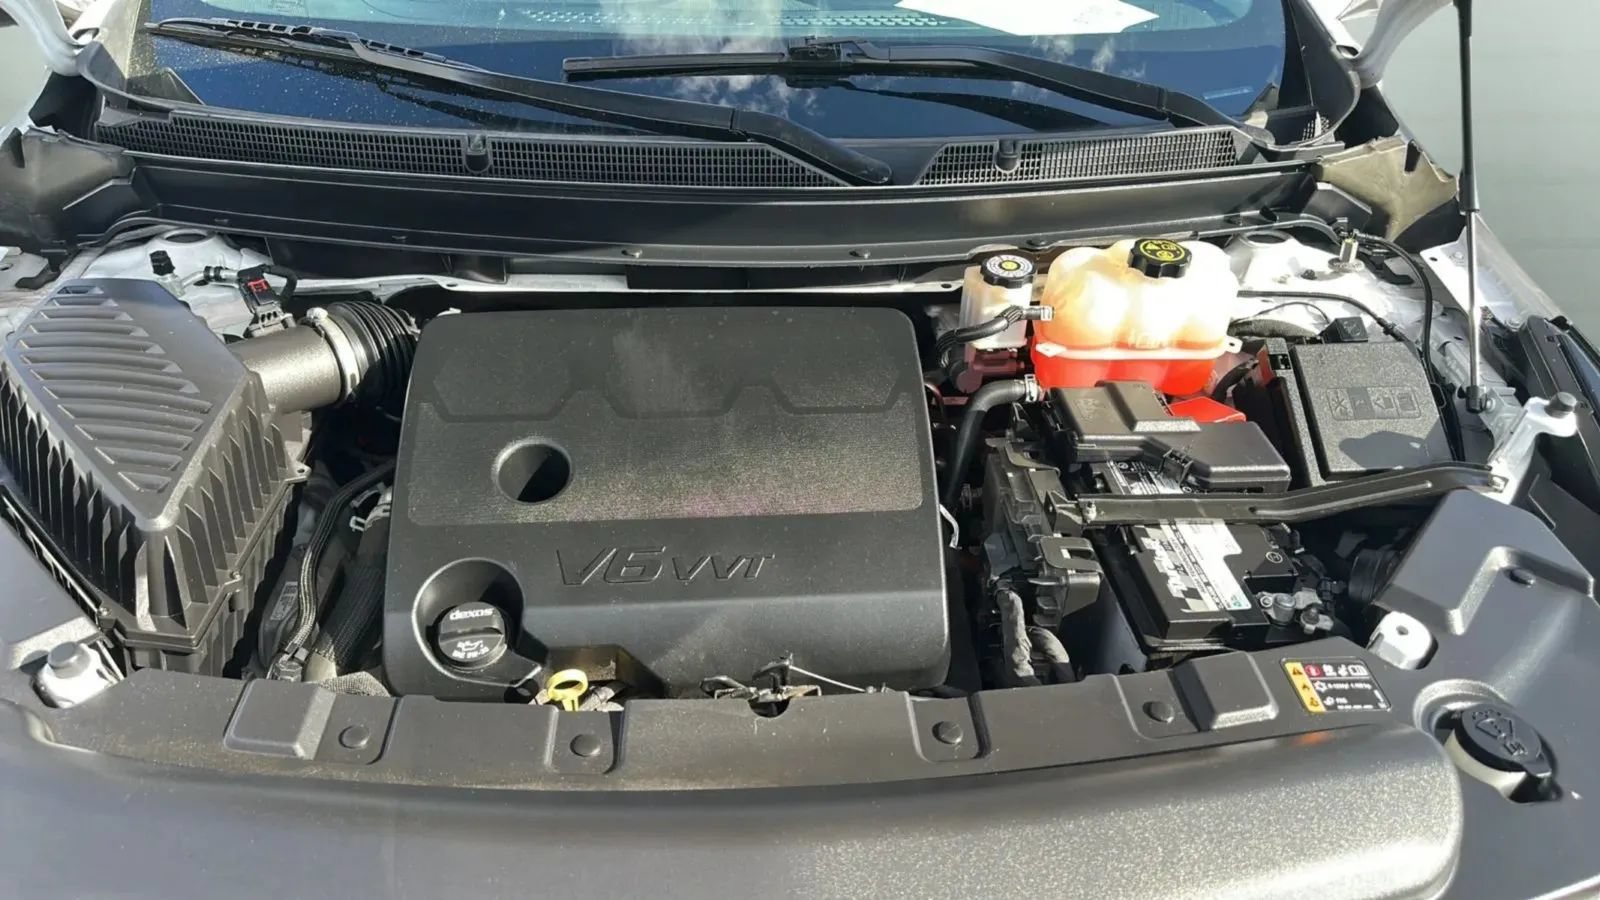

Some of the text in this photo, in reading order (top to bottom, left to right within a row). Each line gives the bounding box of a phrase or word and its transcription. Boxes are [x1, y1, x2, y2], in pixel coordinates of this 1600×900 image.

[556, 546, 776, 586] V6 VVT
[449, 608, 494, 620] dexos
